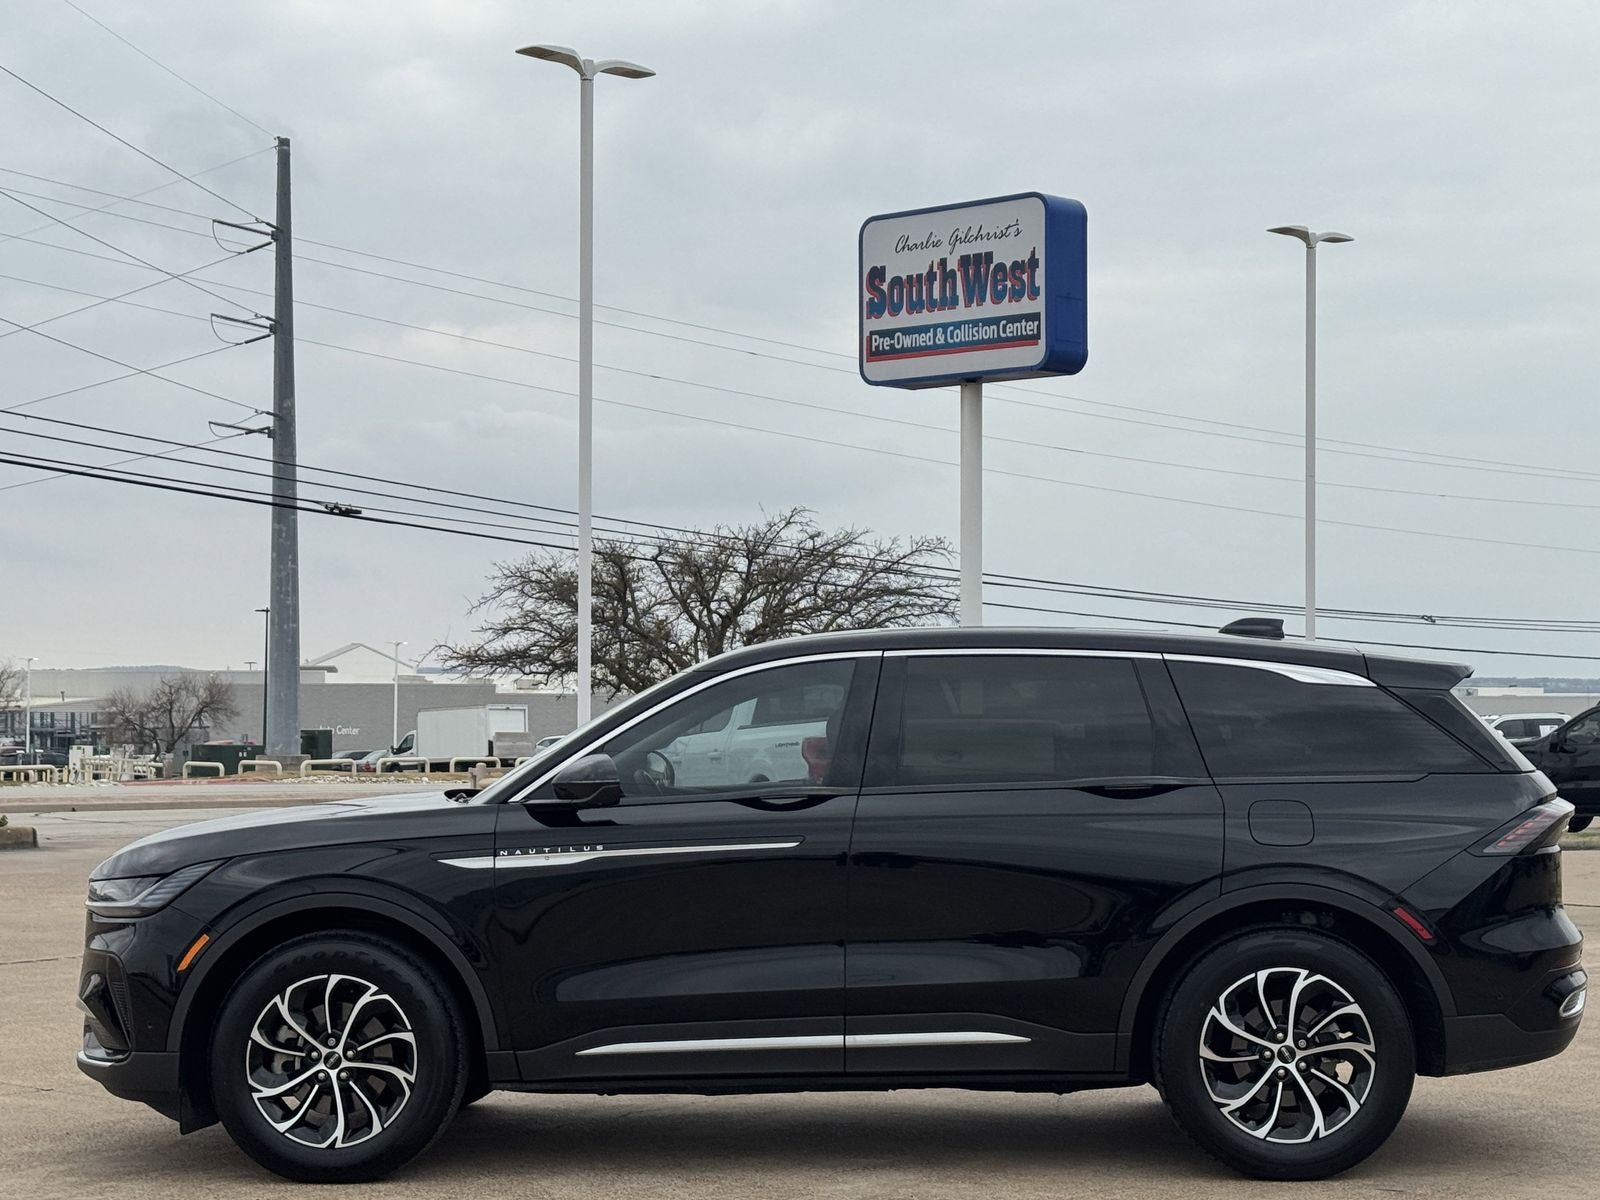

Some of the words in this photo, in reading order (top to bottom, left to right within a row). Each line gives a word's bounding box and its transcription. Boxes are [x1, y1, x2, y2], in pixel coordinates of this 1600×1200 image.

[894, 231, 944, 254] Charlie
[948, 218, 1023, 255] Gilchrist's
[871, 328, 934, 352] Pre-Owned
[935, 327, 945, 344] &
[947, 322, 998, 344] Collision
[999, 318, 1039, 338] Center
[336, 724, 360, 735] Center
[499, 844, 604, 856] NAUTILUS
